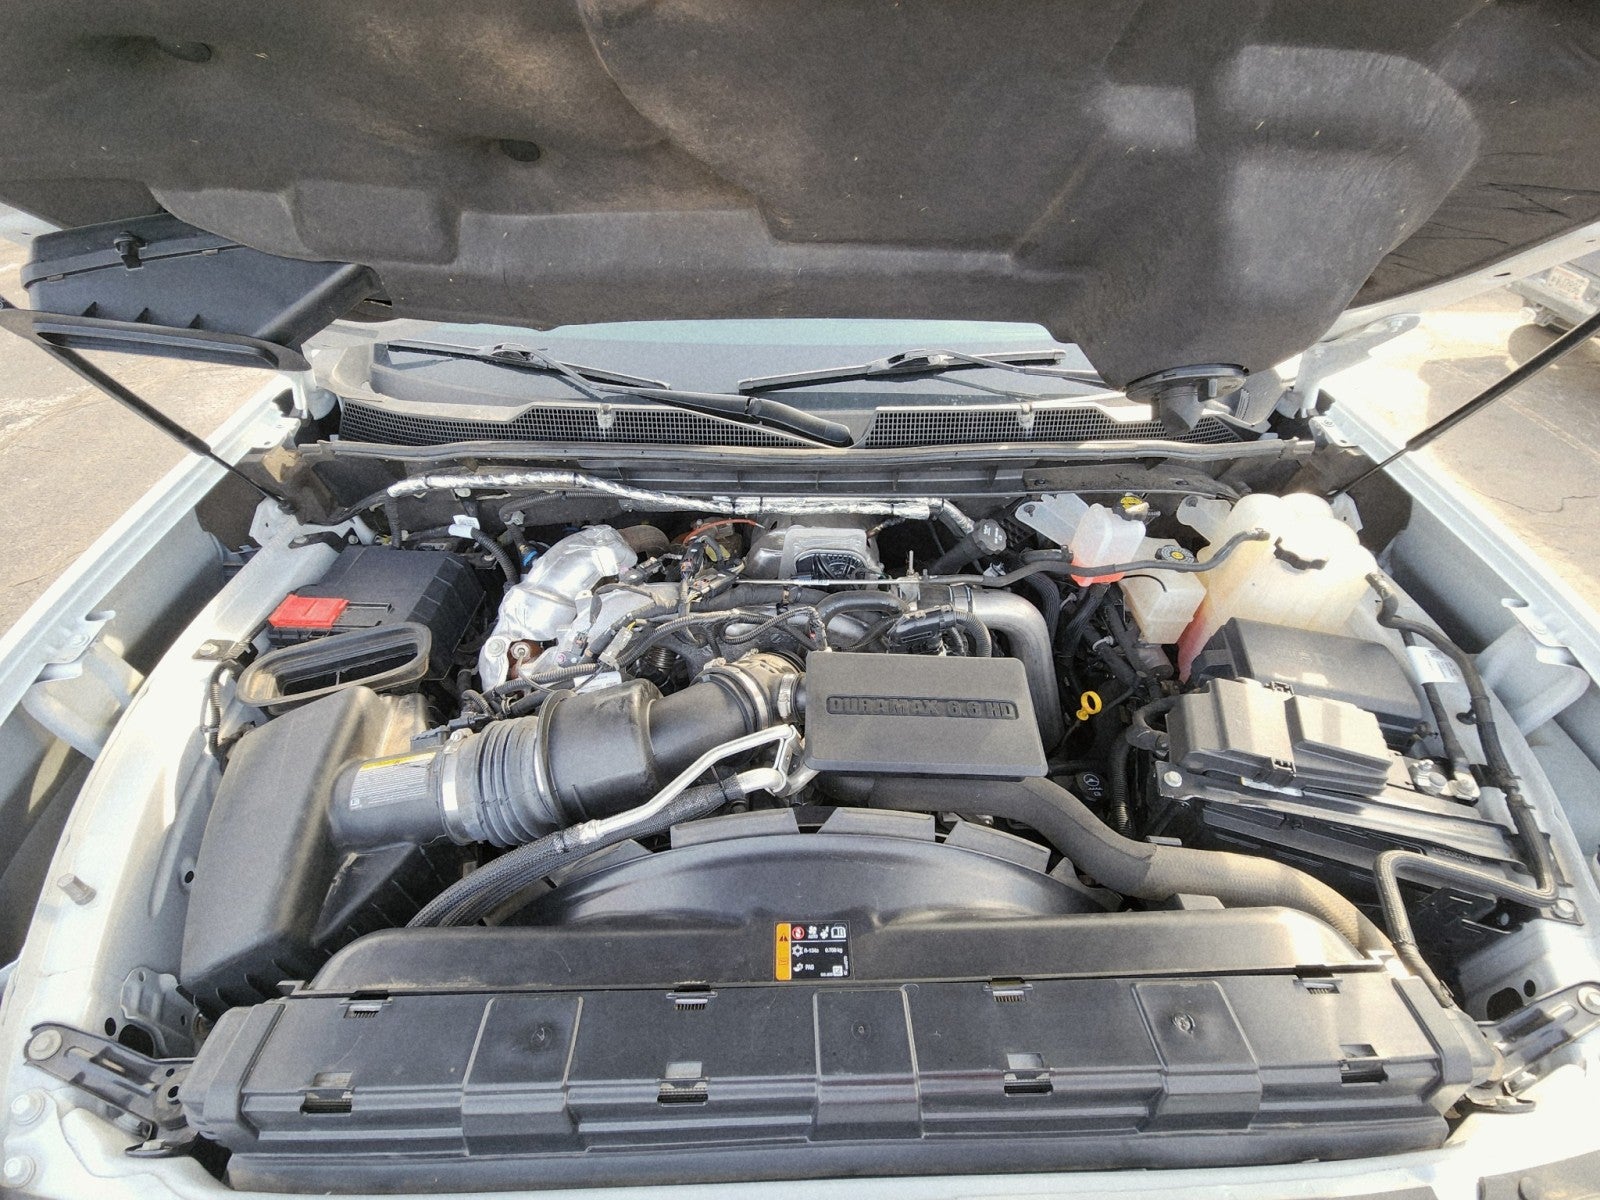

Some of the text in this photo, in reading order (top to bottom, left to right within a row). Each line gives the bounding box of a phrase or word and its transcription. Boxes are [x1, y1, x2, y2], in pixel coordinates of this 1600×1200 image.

[828, 697, 1016, 719] DURAMAX 6.6 HD
